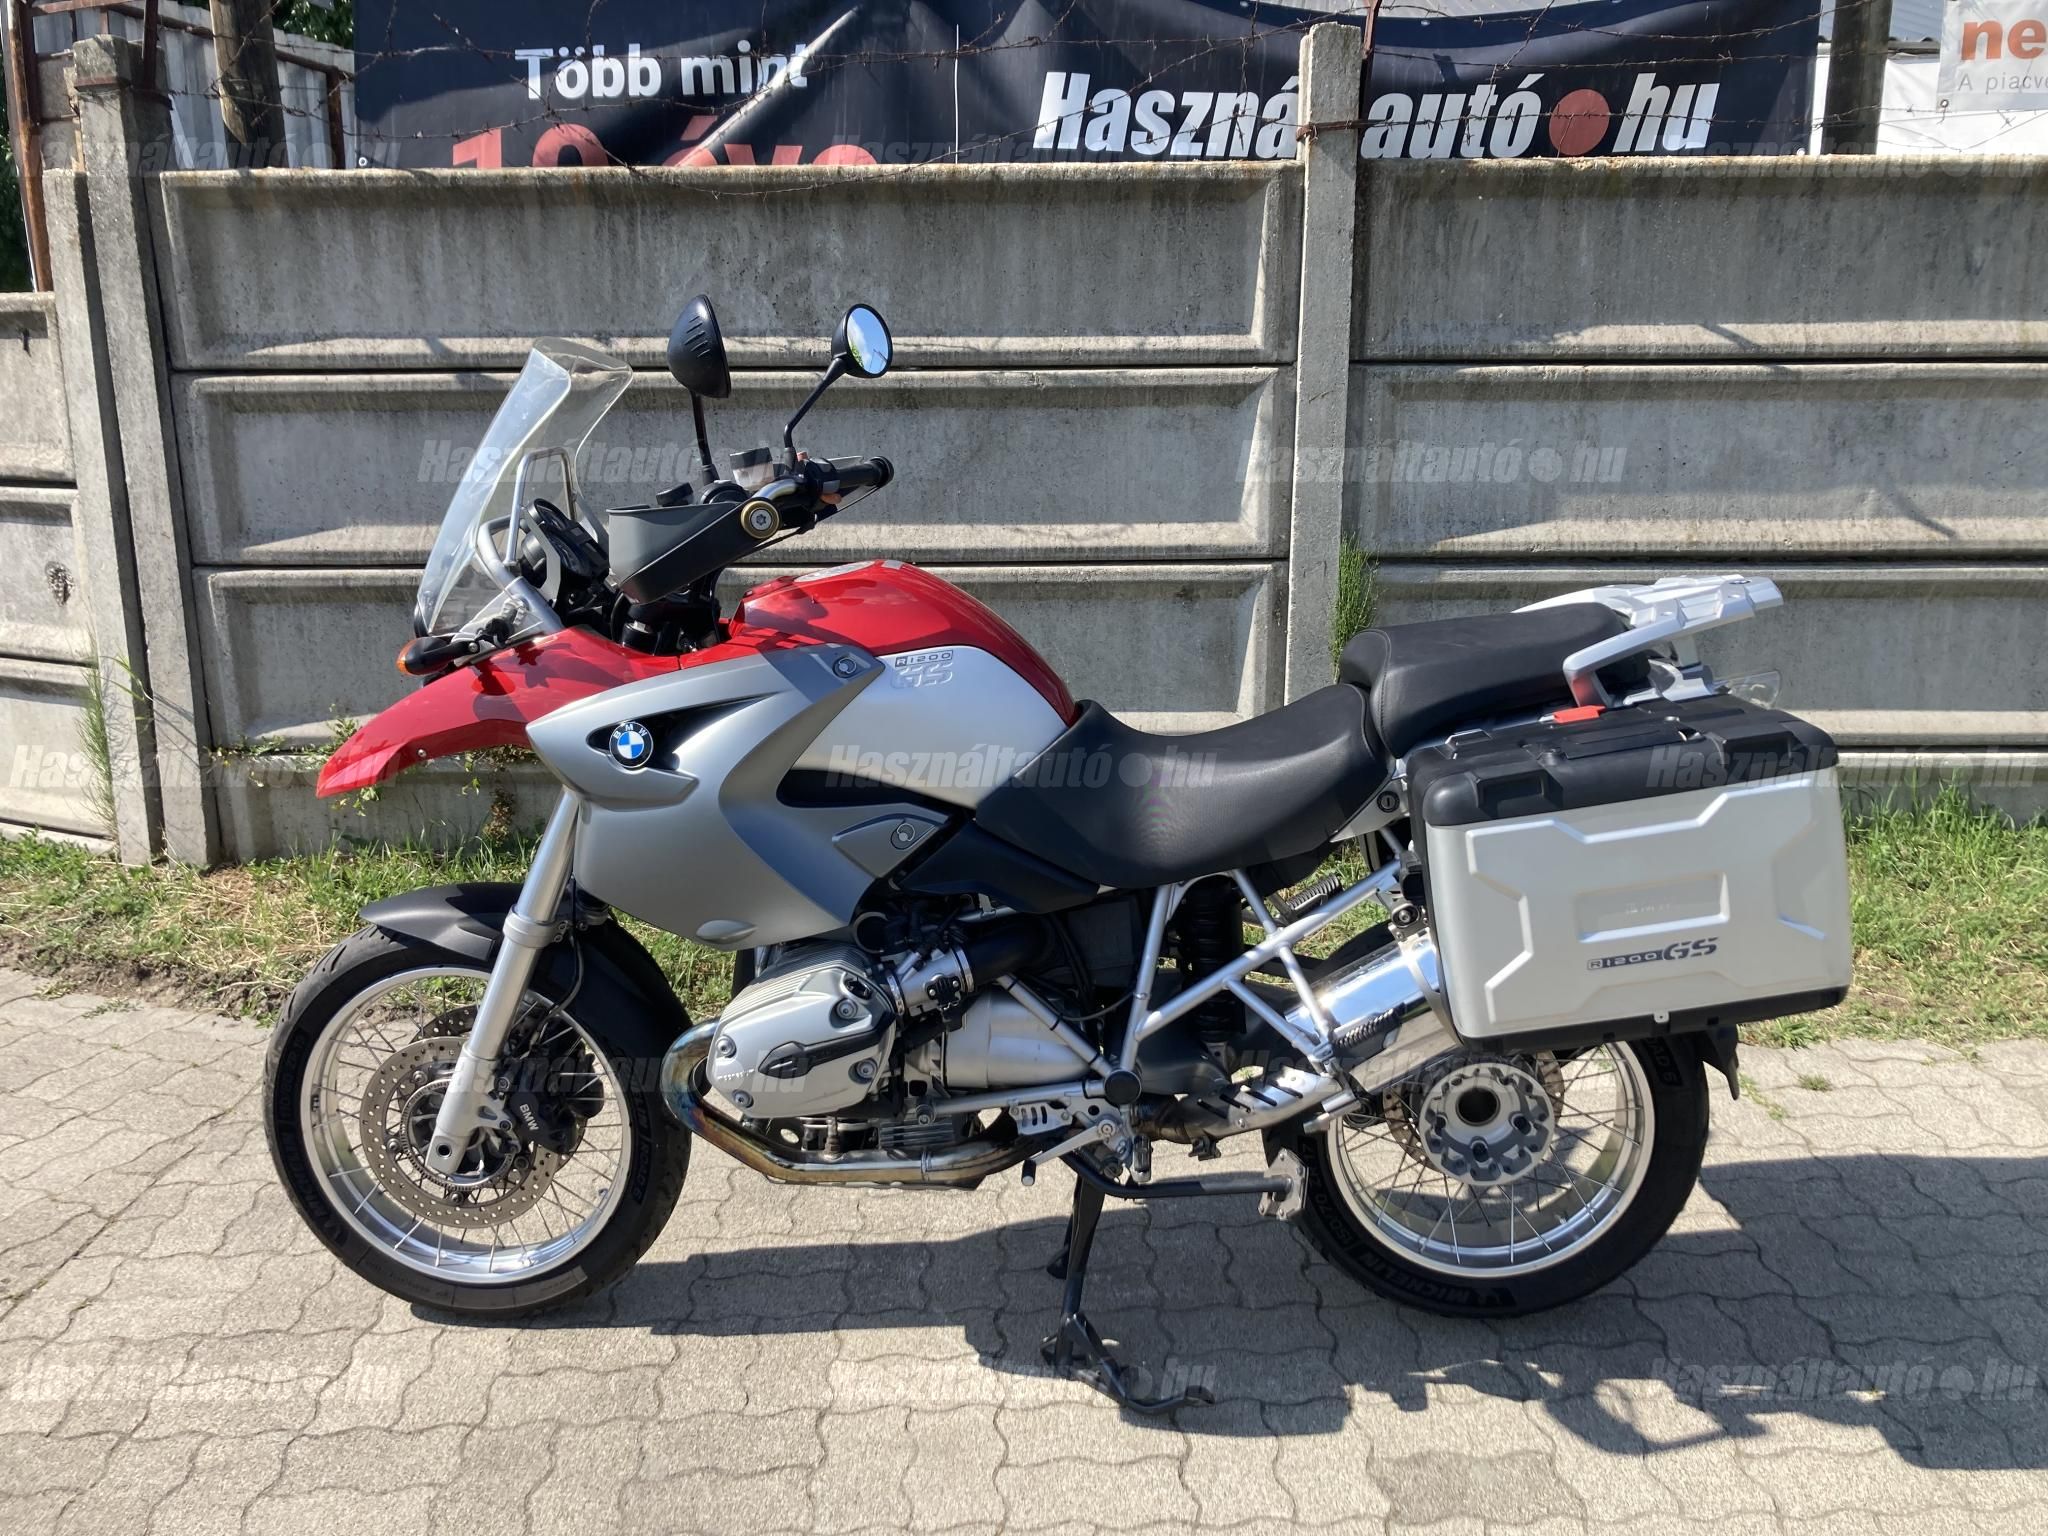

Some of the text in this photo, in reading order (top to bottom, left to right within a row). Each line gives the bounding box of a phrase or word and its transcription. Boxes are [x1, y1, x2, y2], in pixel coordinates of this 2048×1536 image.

[514, 40, 809, 100] Több mint
[1958, 73, 1973, 91] A
[896, 651, 952, 667] R1200
[613, 724, 648, 739] BMW
[520, 1104, 539, 1131] BMW
